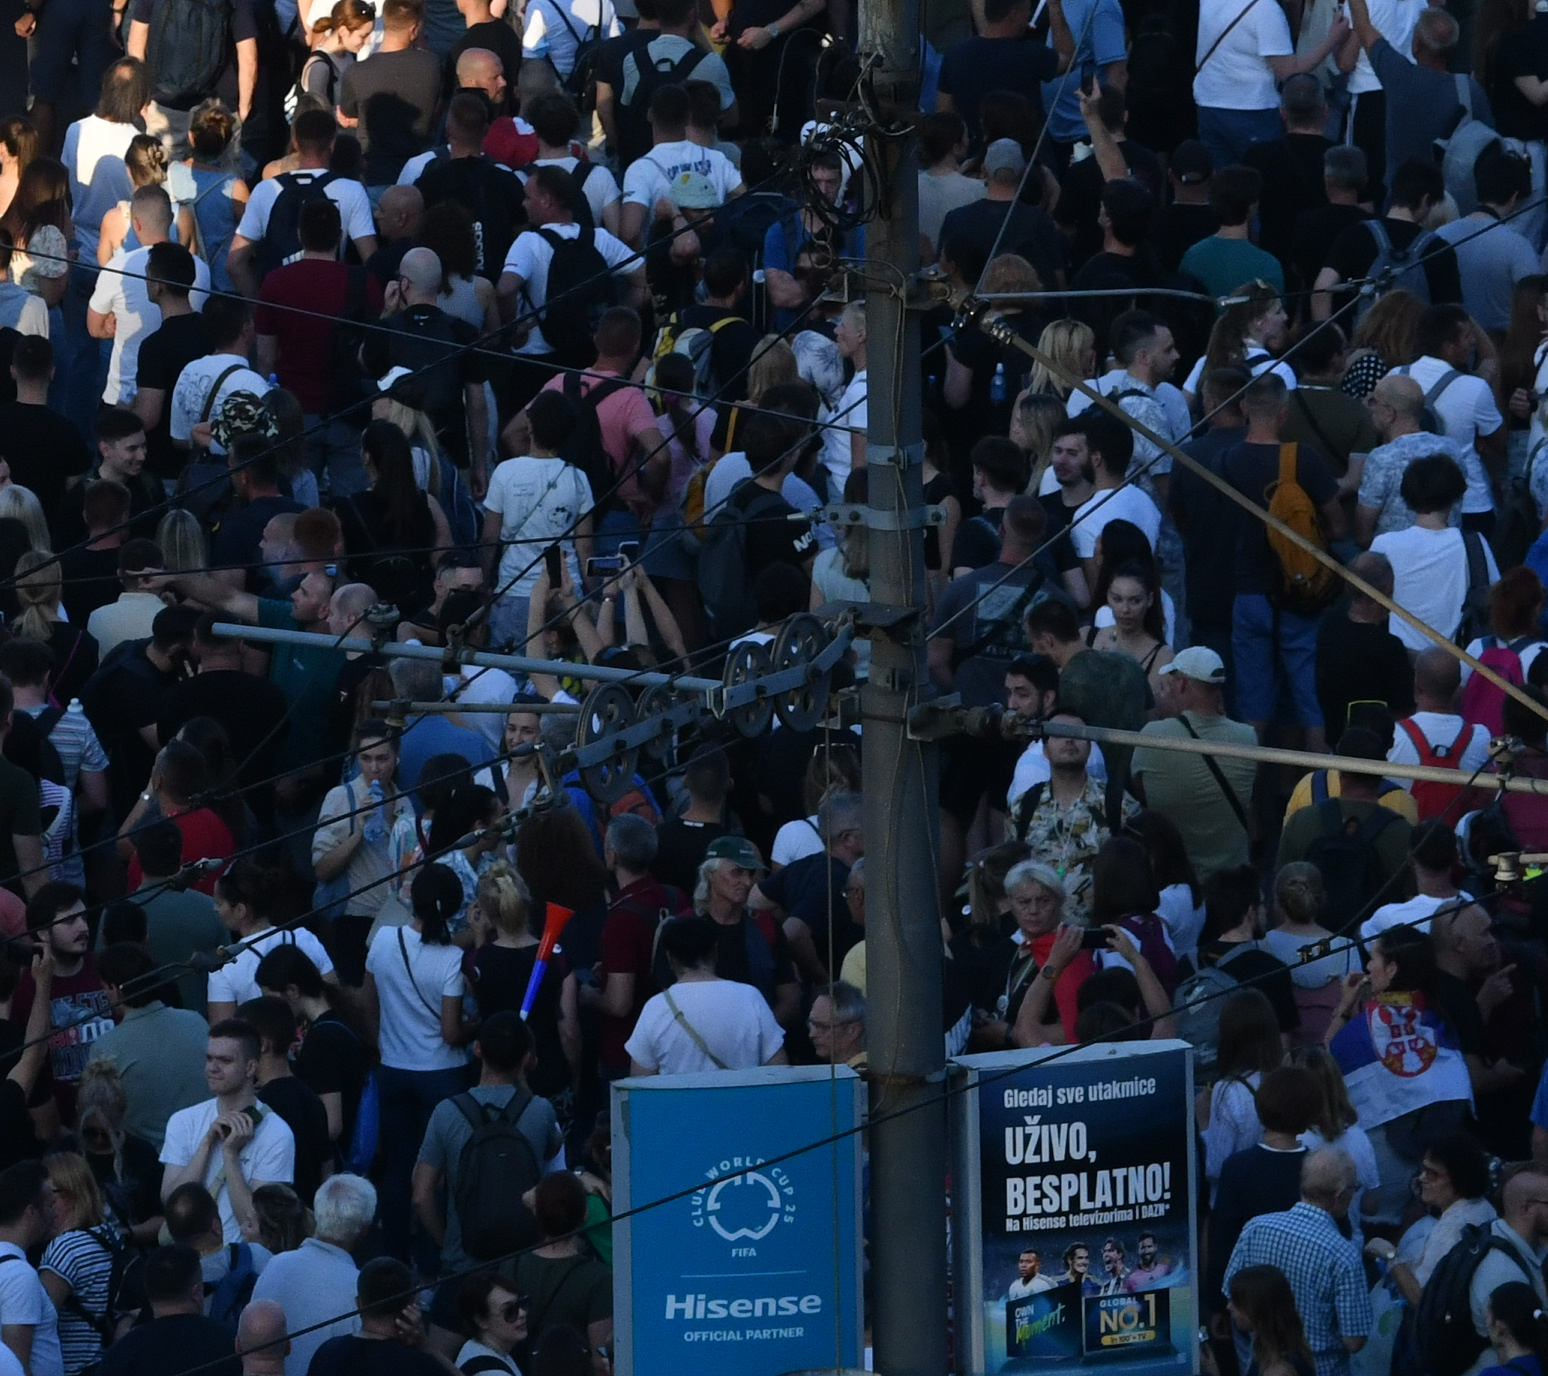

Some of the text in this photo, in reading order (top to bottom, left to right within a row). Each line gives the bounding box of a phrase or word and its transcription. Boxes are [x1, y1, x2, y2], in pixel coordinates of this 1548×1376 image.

[1004, 1075, 1156, 1109] Gledaj sve utakmice
[1005, 1115, 1097, 1165] UŽIVO,
[770, 1167, 794, 1197] CUP
[783, 1204, 798, 1224] 25
[1006, 1161, 1171, 1216] BESPLATNO!
[1005, 1218, 1020, 1232] Na
[1022, 1215, 1066, 1231] Hisense
[1068, 1207, 1133, 1228] televizorima
[731, 1247, 757, 1257] FIFA
[665, 1293, 822, 1320] Hisense
[1014, 1304, 1035, 1319] OWN
[1099, 1297, 1138, 1310] GLOBAL
[1099, 1293, 1156, 1334] NO.1
[683, 1327, 805, 1342] OFFICIAL PARTNER
